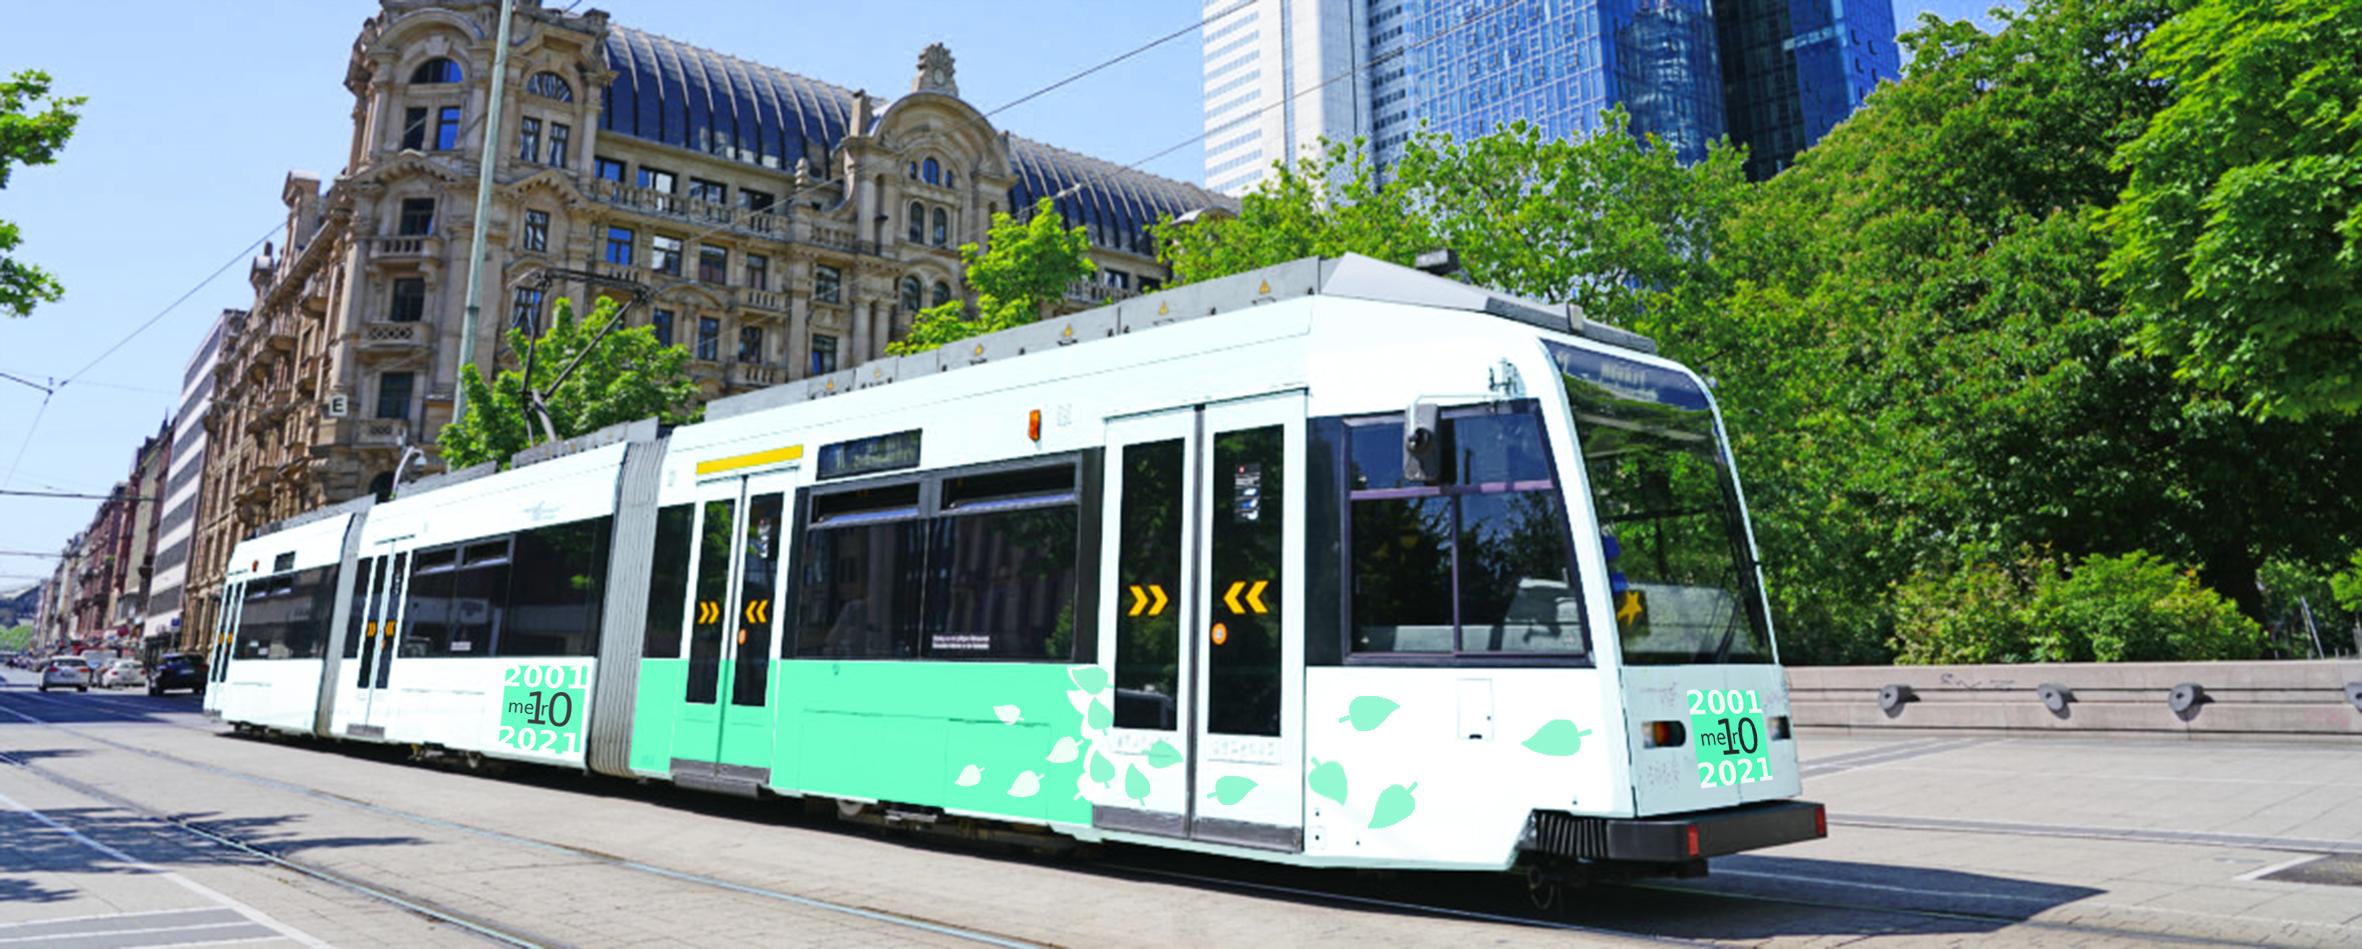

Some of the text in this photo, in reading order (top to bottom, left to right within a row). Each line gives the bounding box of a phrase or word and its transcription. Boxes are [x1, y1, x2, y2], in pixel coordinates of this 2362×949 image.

[332, 397, 344, 412] E
[503, 663, 587, 689] 2001
[1686, 689, 1764, 715] 2001
[498, 725, 581, 756] 2021
[1697, 757, 1774, 789] 2021
